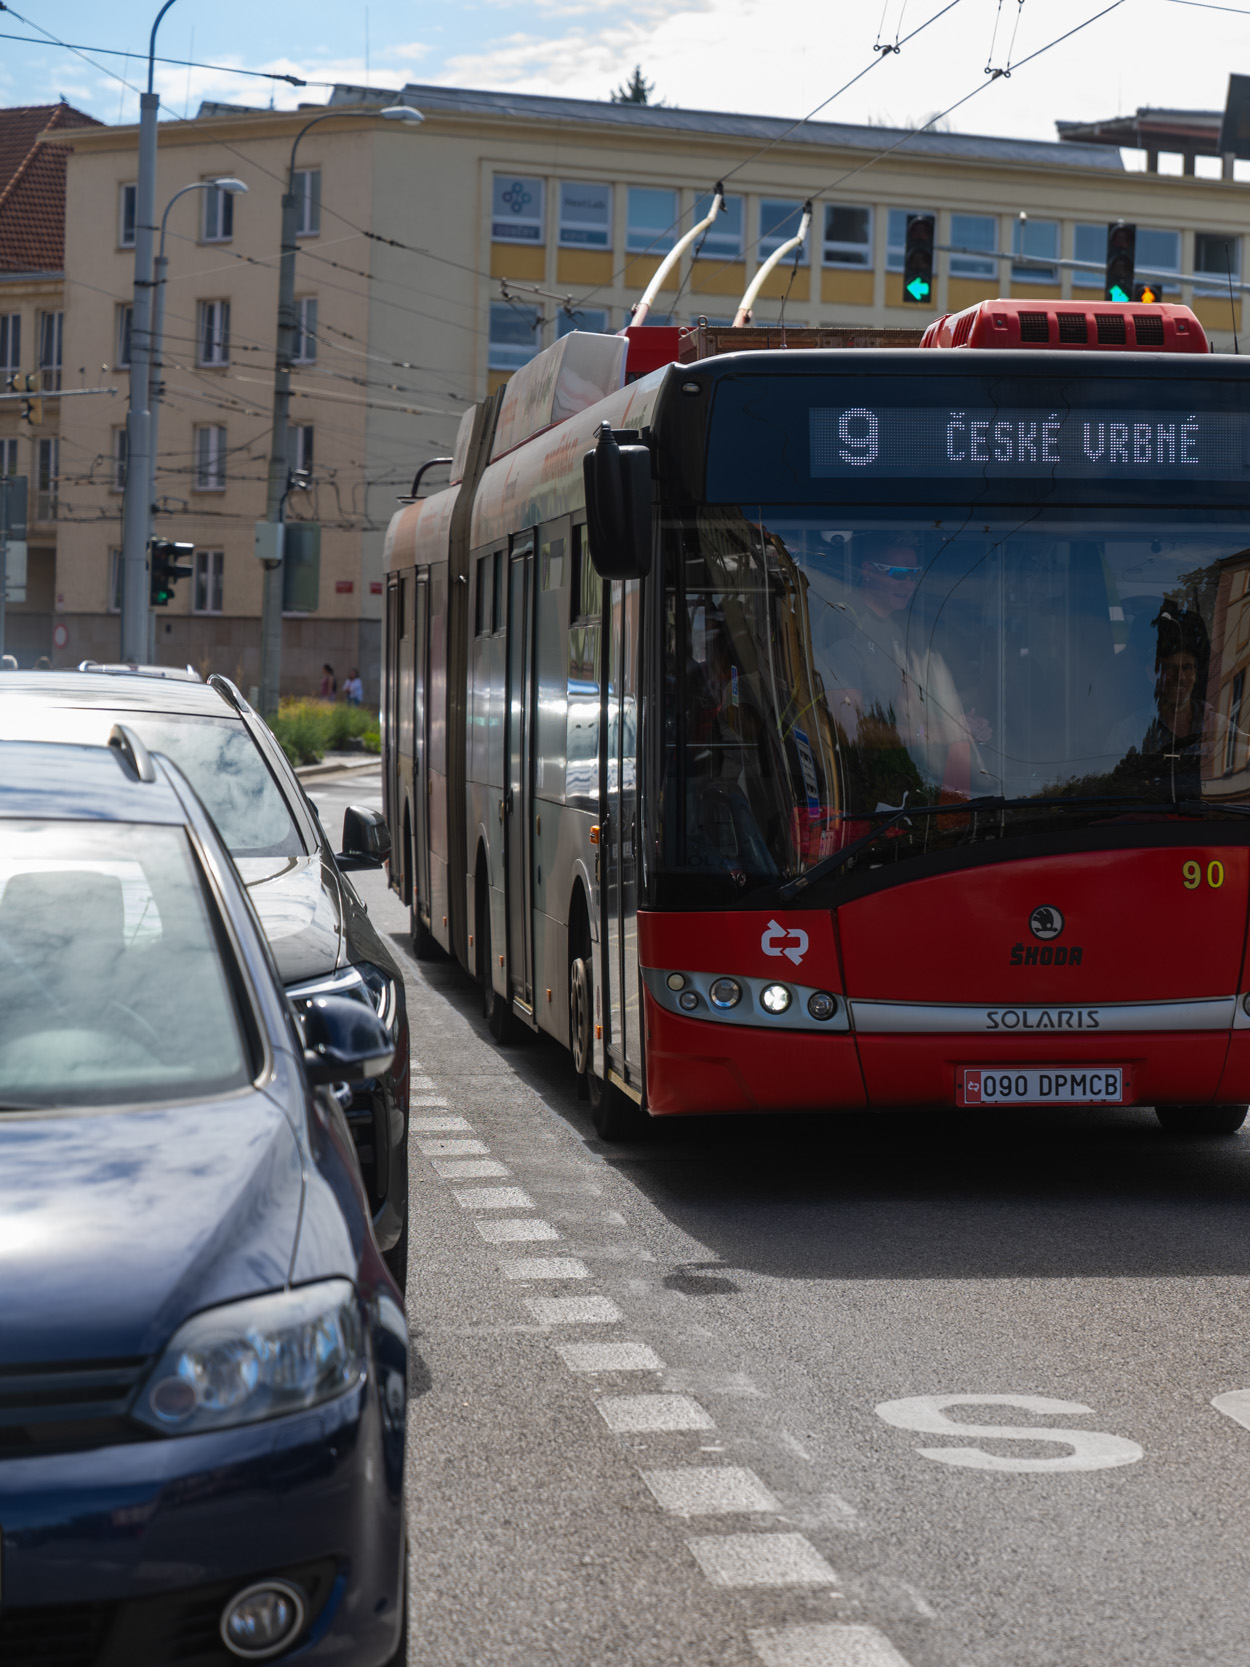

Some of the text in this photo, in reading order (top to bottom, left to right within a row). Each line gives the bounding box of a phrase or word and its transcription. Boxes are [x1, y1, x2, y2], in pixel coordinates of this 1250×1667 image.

[838, 407, 879, 466] 9
[947, 412, 1200, 464] ČESKÉ VRBNÉ
[1182, 859, 1225, 890] 90
[1009, 942, 1084, 966] ŠKODA
[985, 1009, 1100, 1029] SOLARIS
[983, 1073, 1119, 1097] 090 DPMCB
